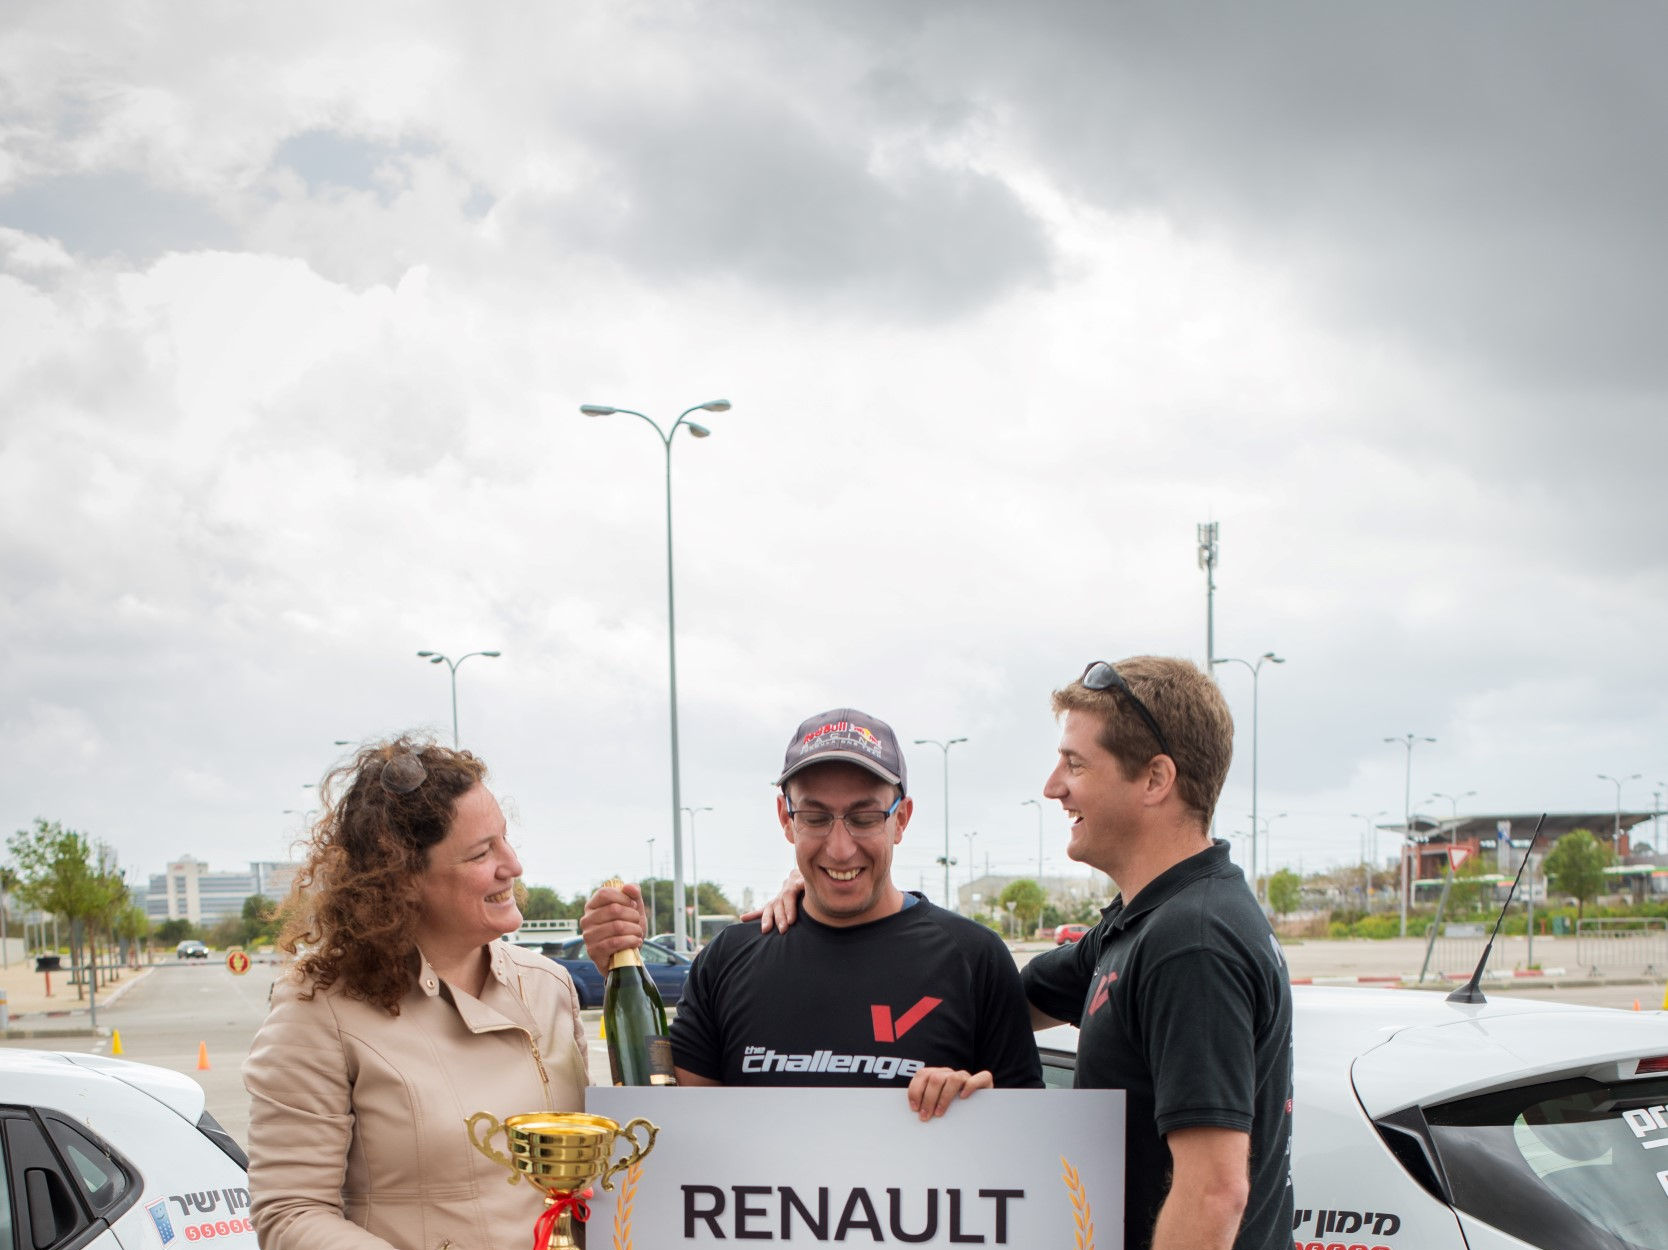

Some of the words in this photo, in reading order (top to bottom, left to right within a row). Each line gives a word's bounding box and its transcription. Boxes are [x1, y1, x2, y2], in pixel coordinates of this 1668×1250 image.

[823, 721, 848, 734] Bull
[745, 1046, 766, 1055] the
[169, 1190, 220, 1216] ישיר
[680, 1184, 1025, 1244] RENAULT
[1315, 1209, 1400, 1238] מימון
